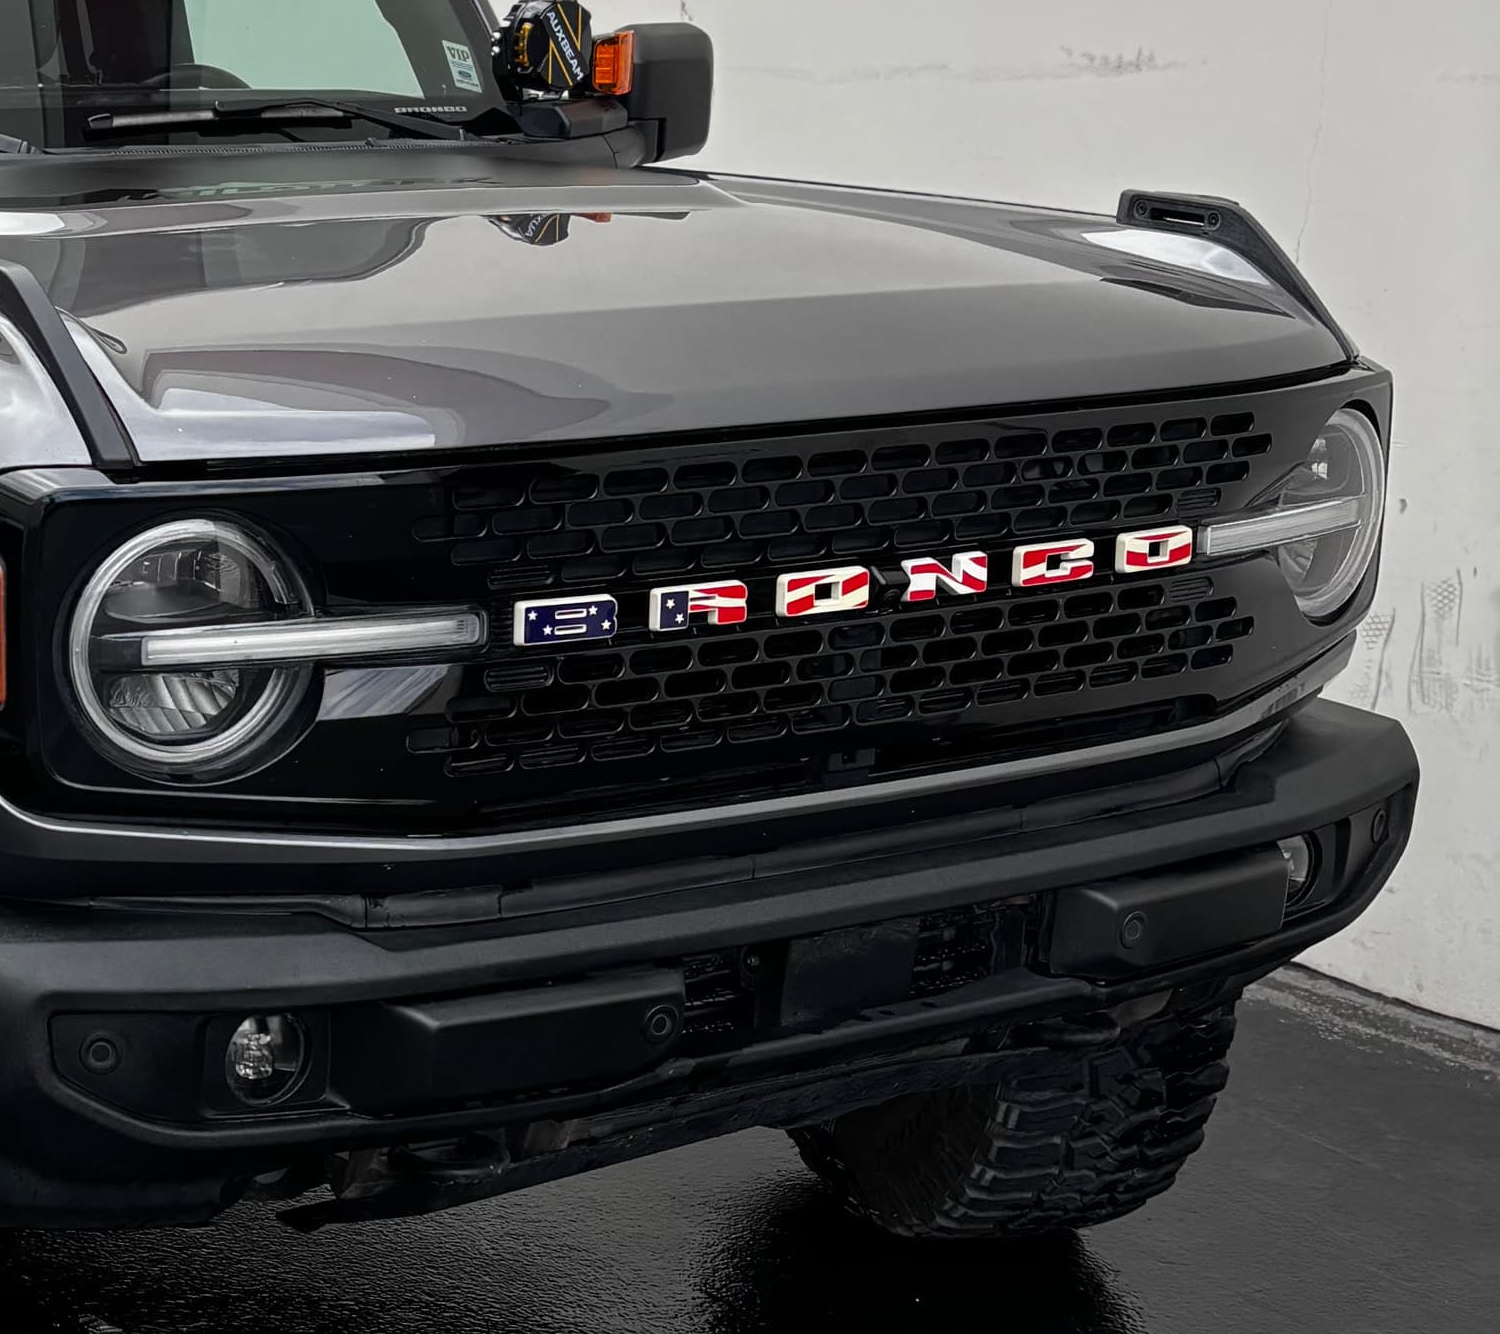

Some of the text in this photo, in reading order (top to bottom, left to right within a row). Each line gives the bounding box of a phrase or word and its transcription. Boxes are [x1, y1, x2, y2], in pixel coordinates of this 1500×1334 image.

[446, 46, 470, 62] VIP
[546, 11, 584, 81] AUXBEAM
[513, 525, 1192, 646] BRONCO
